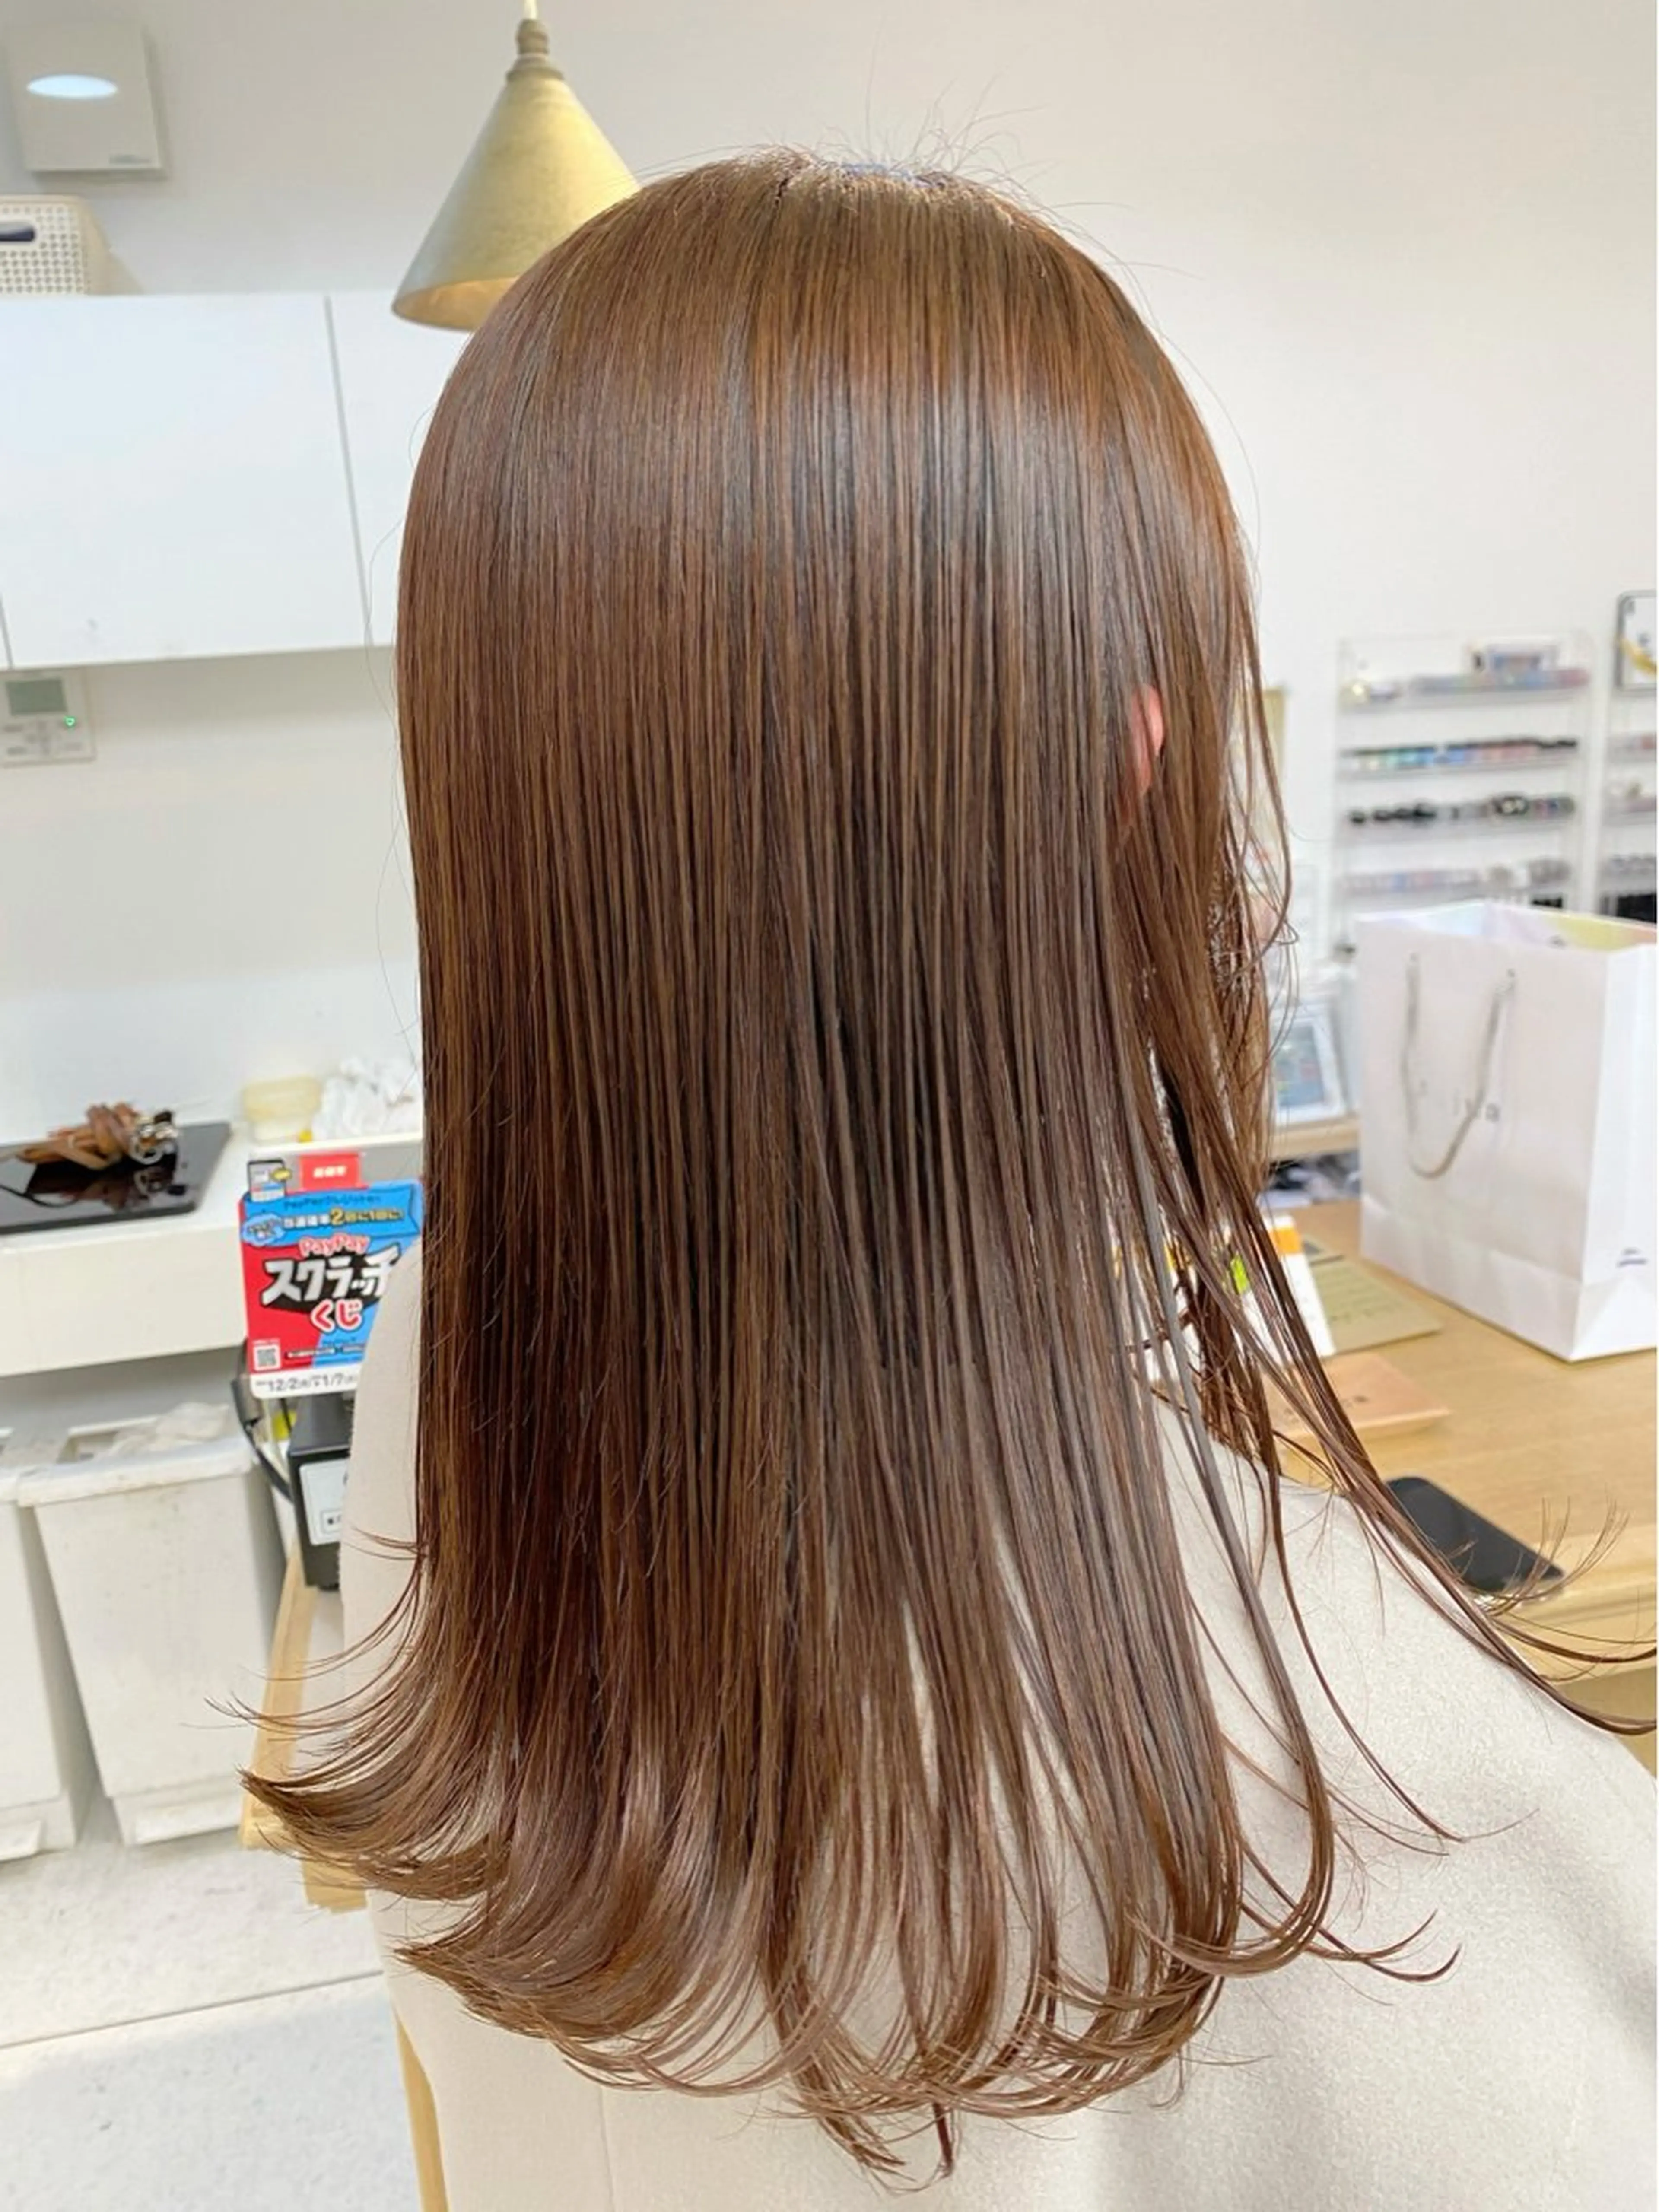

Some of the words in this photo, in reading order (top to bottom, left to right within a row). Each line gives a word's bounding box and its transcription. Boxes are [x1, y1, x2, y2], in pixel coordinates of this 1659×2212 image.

[299, 1234, 370, 1256] PayPay
[261, 1243, 400, 1306] スクラッチ
[311, 1300, 363, 1331] くじ
